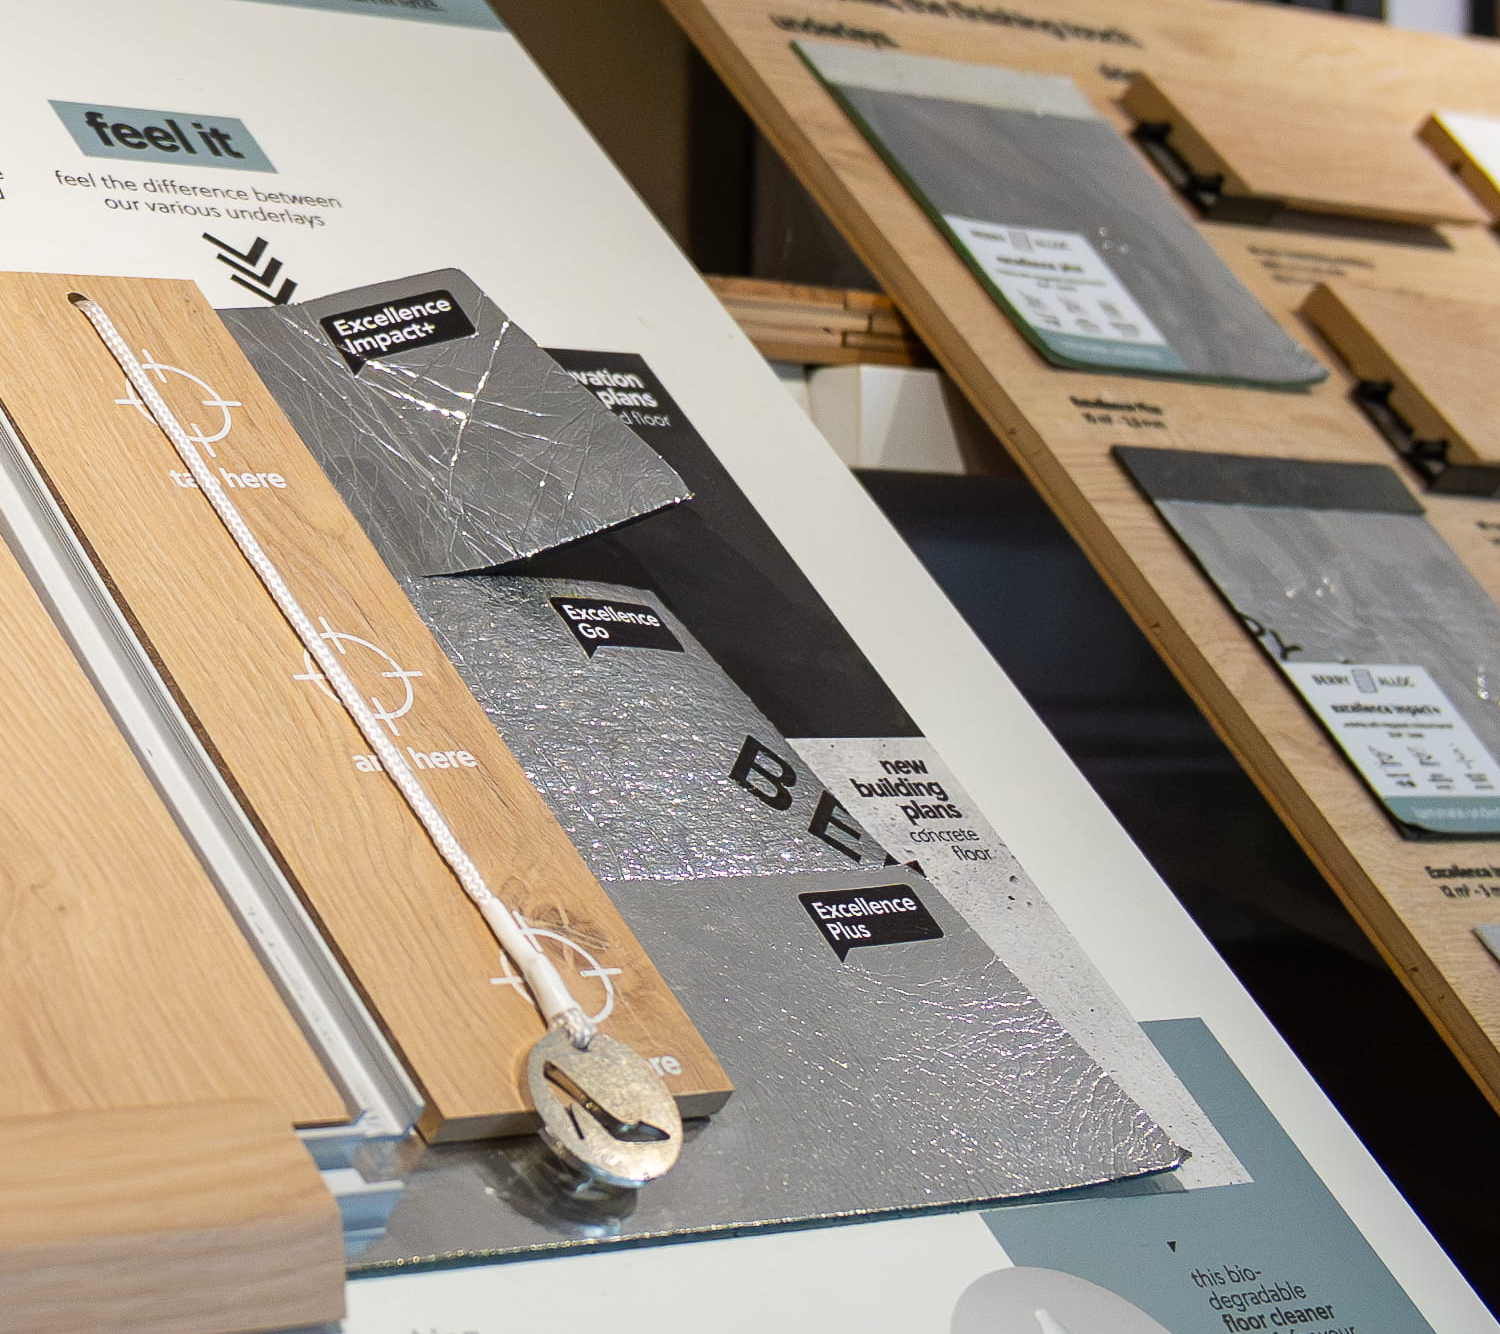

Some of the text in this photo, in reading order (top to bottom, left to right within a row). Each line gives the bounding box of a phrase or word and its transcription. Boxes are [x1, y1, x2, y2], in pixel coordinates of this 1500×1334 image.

[84, 111, 246, 159] feel it
[55, 170, 343, 209] feel the difference between
[104, 197, 327, 229] our various underlays
[333, 297, 453, 338] Excellence
[344, 319, 437, 356] Impact+
[599, 389, 659, 410] plans
[633, 411, 673, 429] floor
[219, 466, 288, 490] here
[562, 604, 662, 628] Excellence
[577, 622, 611, 640] Go
[406, 746, 478, 771] here
[878, 758, 930, 776] new
[849, 777, 950, 803] building
[900, 801, 964, 826] plans
[909, 827, 981, 844] concrete
[952, 844, 994, 862] floor
[811, 895, 918, 921] Excellence
[826, 921, 872, 942] Plus
[648, 1054, 683, 1078] re
[1191, 1265, 1262, 1289] this bio-
[1208, 1280, 1308, 1313] degradable
[1222, 1303, 1337, 1334] floor cleaner
